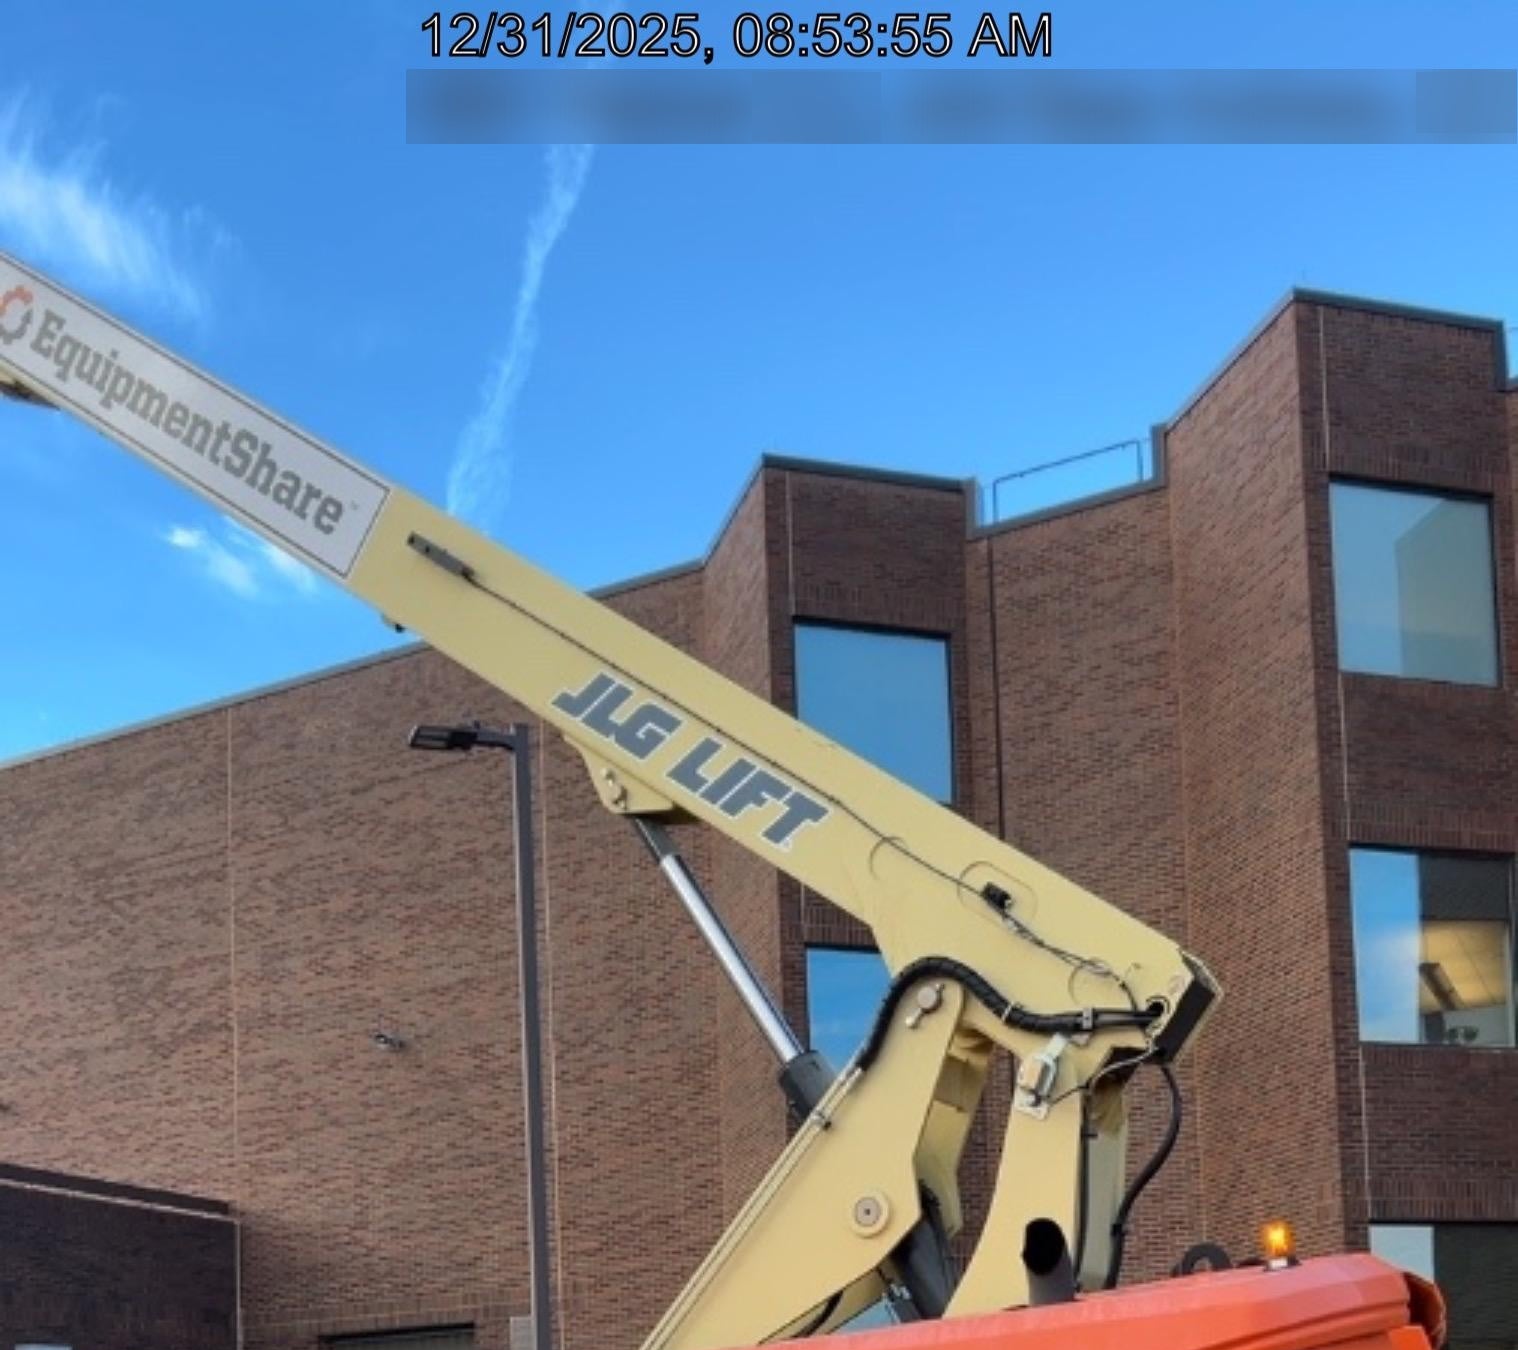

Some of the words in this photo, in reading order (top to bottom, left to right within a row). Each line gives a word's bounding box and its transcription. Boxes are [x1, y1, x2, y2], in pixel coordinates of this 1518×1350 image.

[29, 308, 344, 536] EquipmentShare
[551, 671, 684, 761] JLG
[664, 736, 831, 848] LIFT
